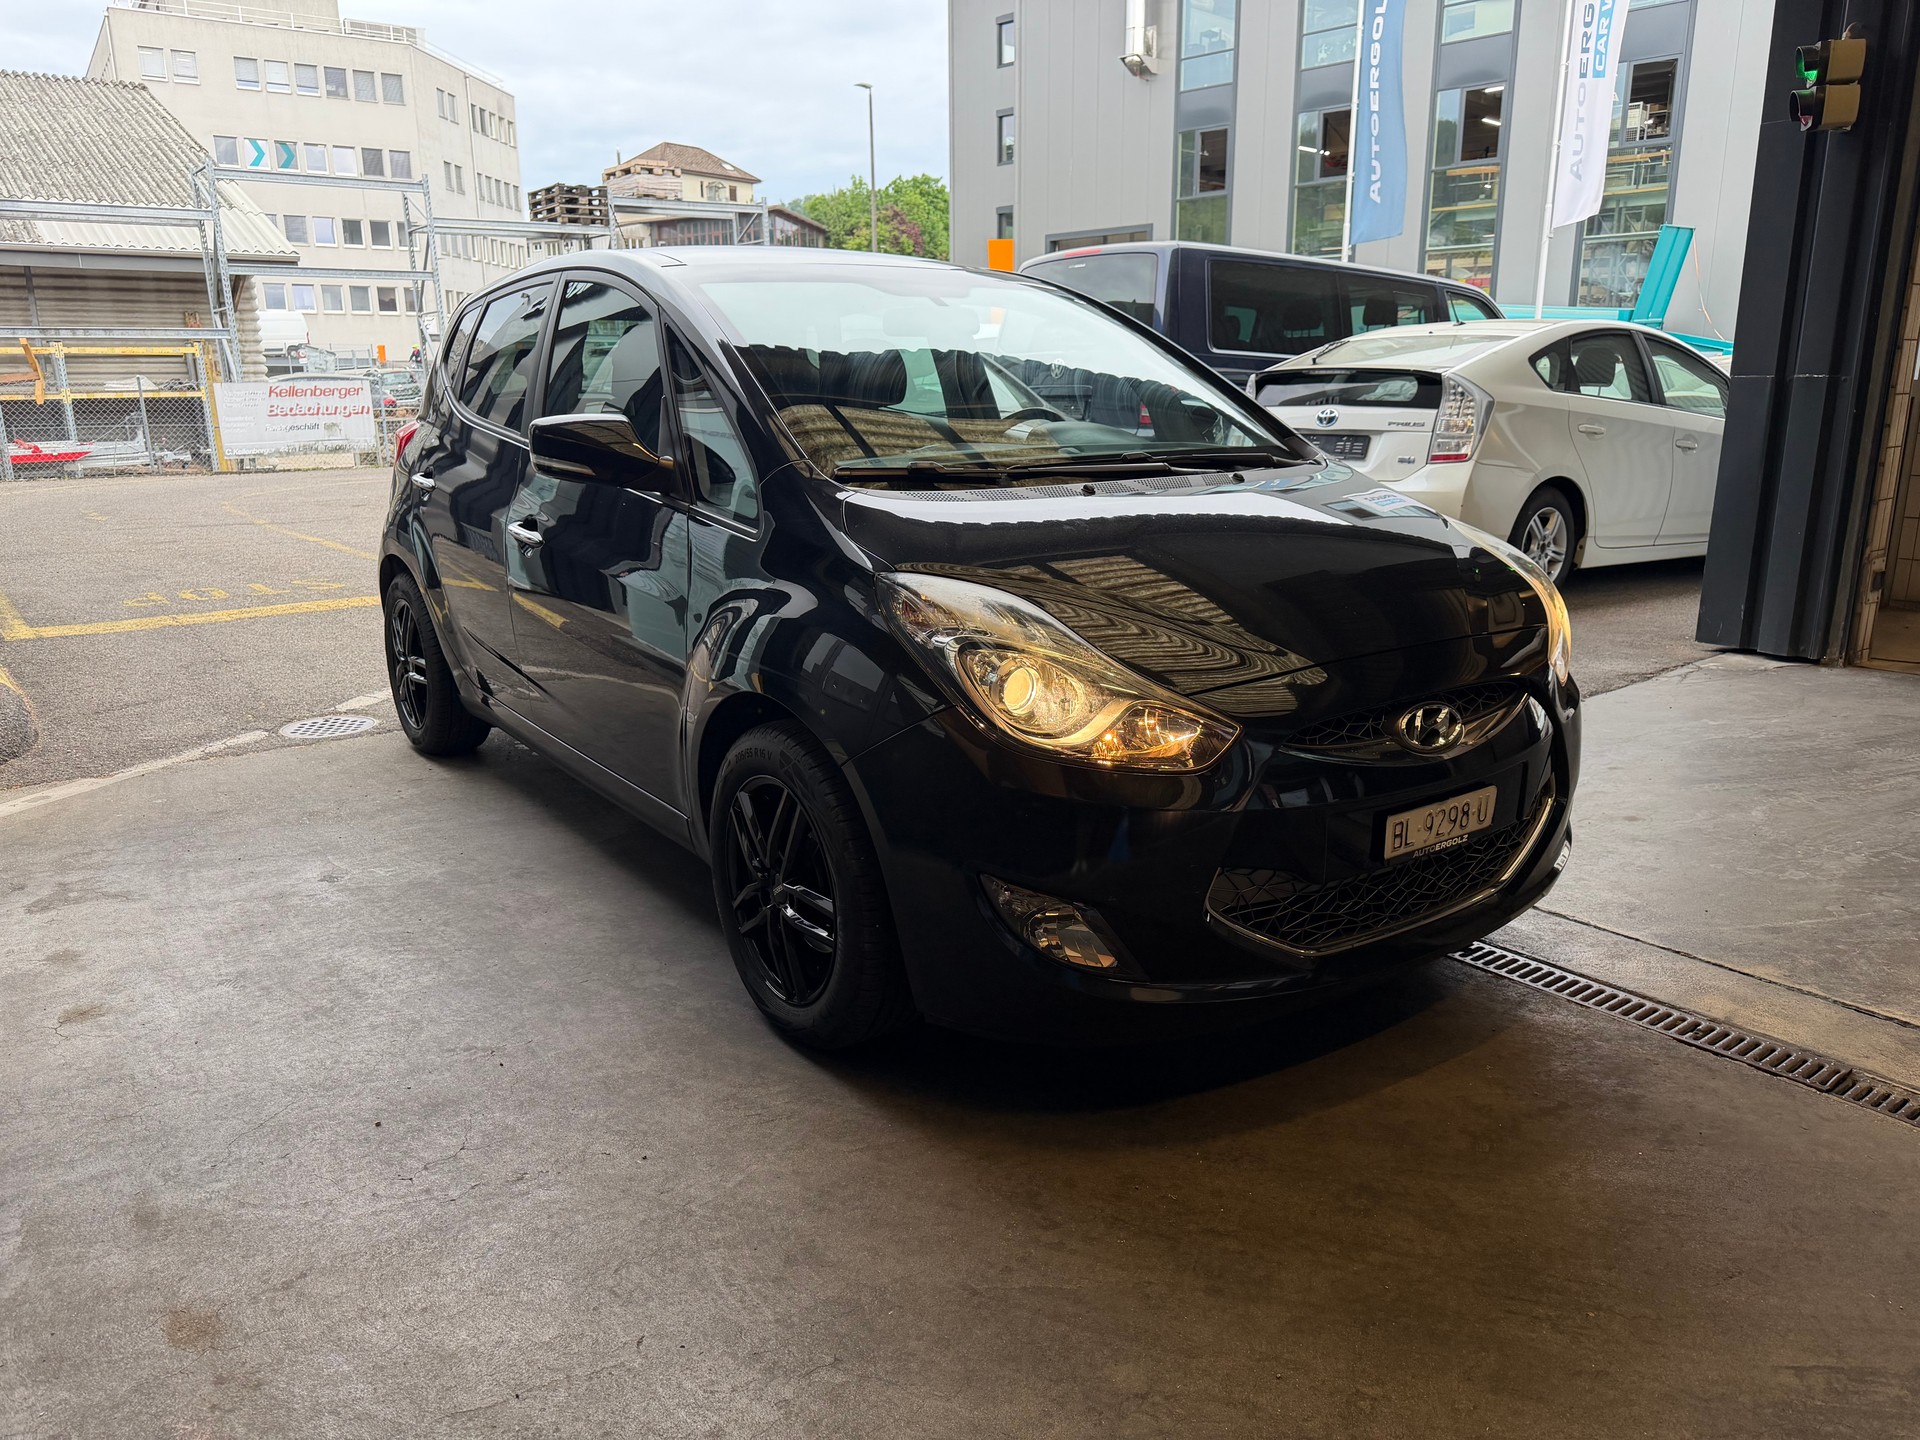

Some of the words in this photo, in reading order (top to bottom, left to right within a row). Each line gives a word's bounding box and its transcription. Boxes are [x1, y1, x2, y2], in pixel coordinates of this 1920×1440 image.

[1595, 16, 1610, 72] CAR
[1369, 0, 1388, 204] AUTOERGOL
[1569, 2, 1595, 182] AUTOERG
[267, 403, 371, 417] Bedachungen
[268, 385, 364, 399] Kellenberger
[122, 578, 346, 607] STOP
[1391, 817, 1415, 852] BL
[1423, 799, 1471, 844] 9298
[1477, 793, 1491, 825] U
[1412, 834, 1469, 859] AUTOERGOLZ
